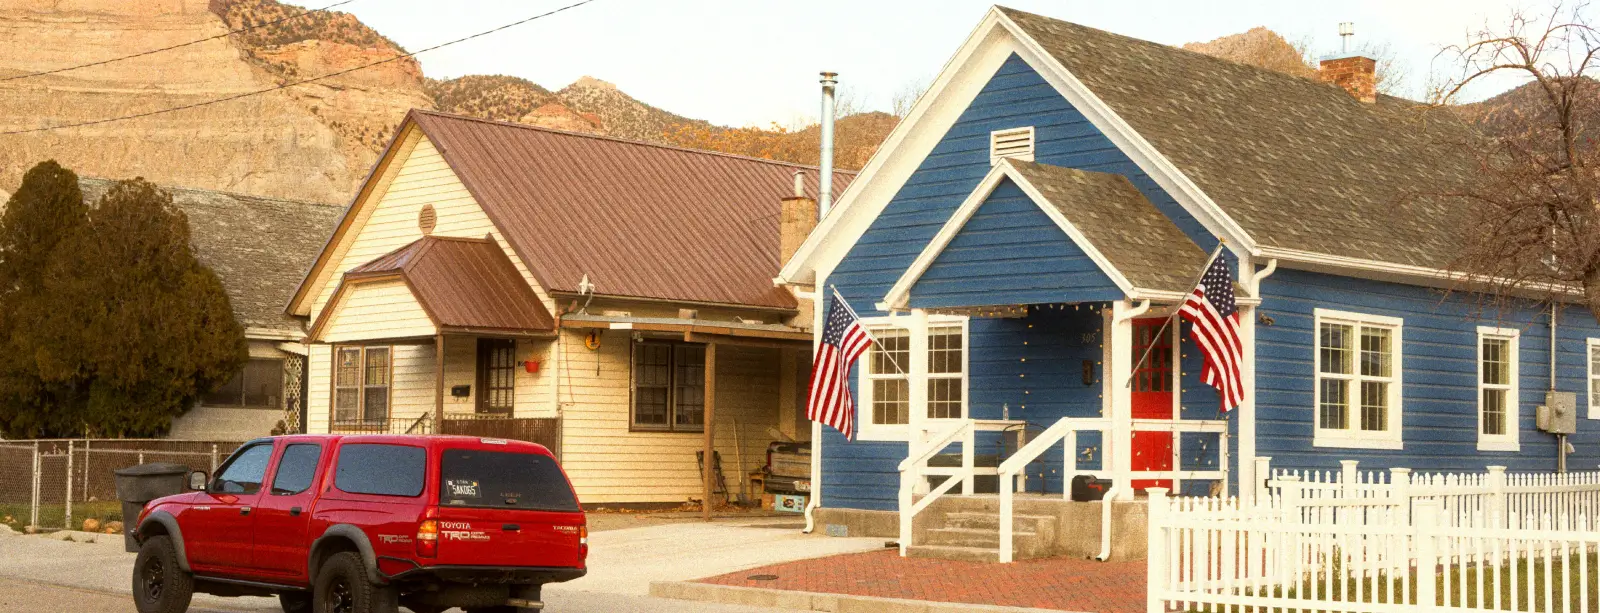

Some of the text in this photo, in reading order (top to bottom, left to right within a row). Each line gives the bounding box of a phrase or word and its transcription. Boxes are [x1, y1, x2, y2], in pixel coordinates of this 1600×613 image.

[1080, 332, 1096, 344] 305
[440, 521, 471, 530] TOYOTA
[377, 534, 398, 544] TRD
[440, 530, 471, 541] TRD
